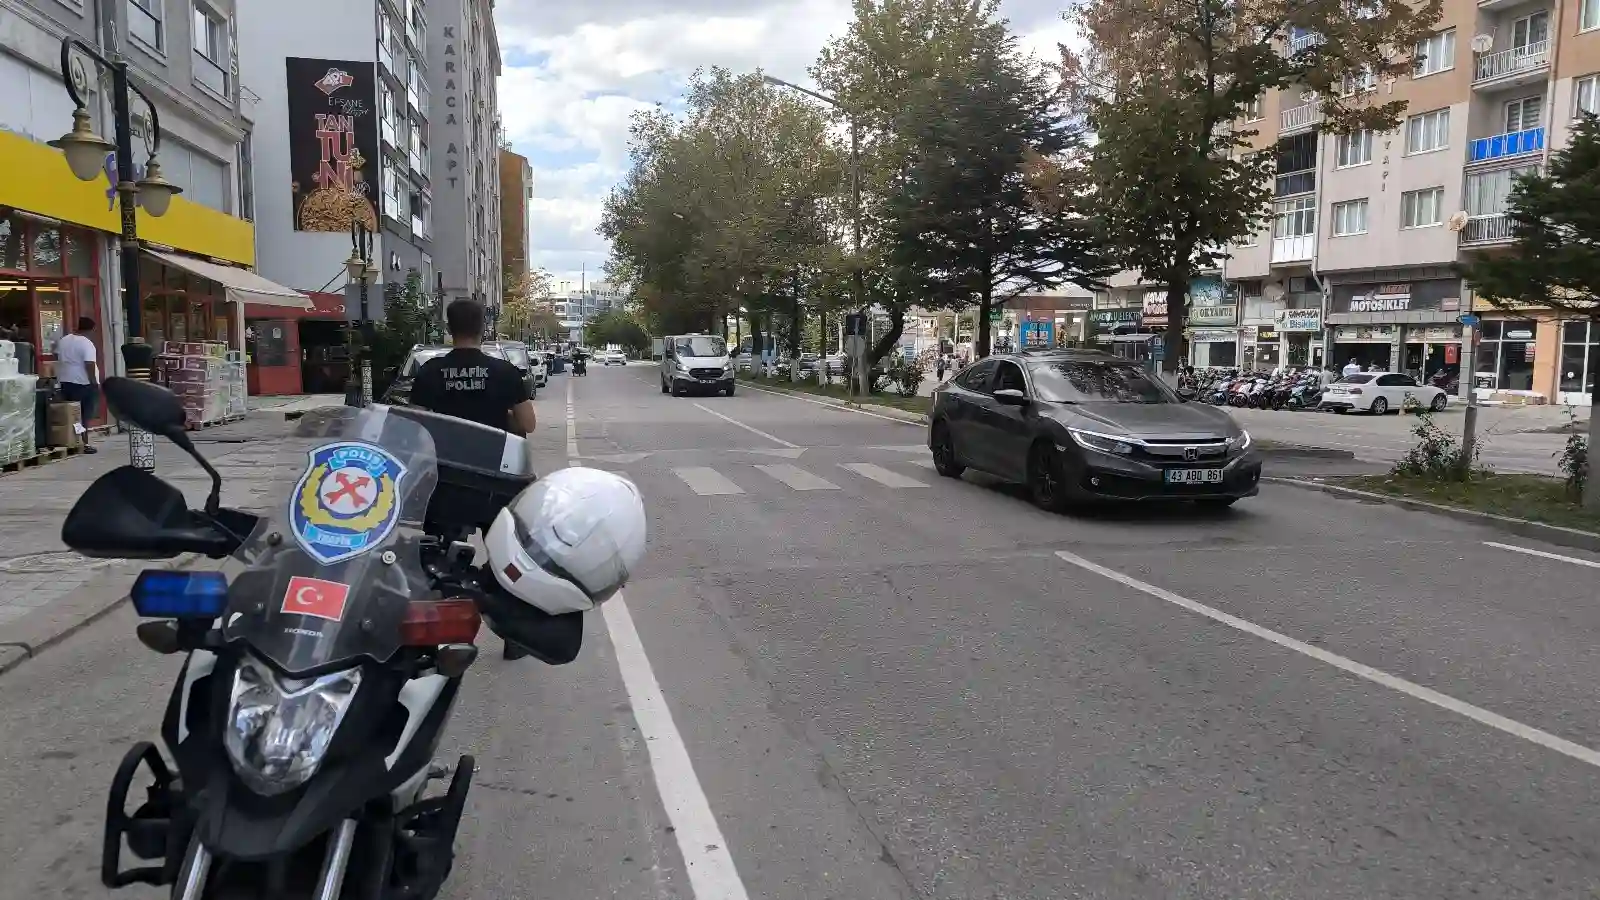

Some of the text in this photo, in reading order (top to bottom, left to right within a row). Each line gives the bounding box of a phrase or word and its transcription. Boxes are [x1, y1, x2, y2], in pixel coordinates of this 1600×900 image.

[328, 96, 363, 108] EFSANE
[443, 26, 458, 190] KARACA APT
[315, 113, 354, 132] TAN
[315, 130, 354, 162] TU
[1171, 470, 1183, 481] 43
[1207, 469, 1222, 480] 861
